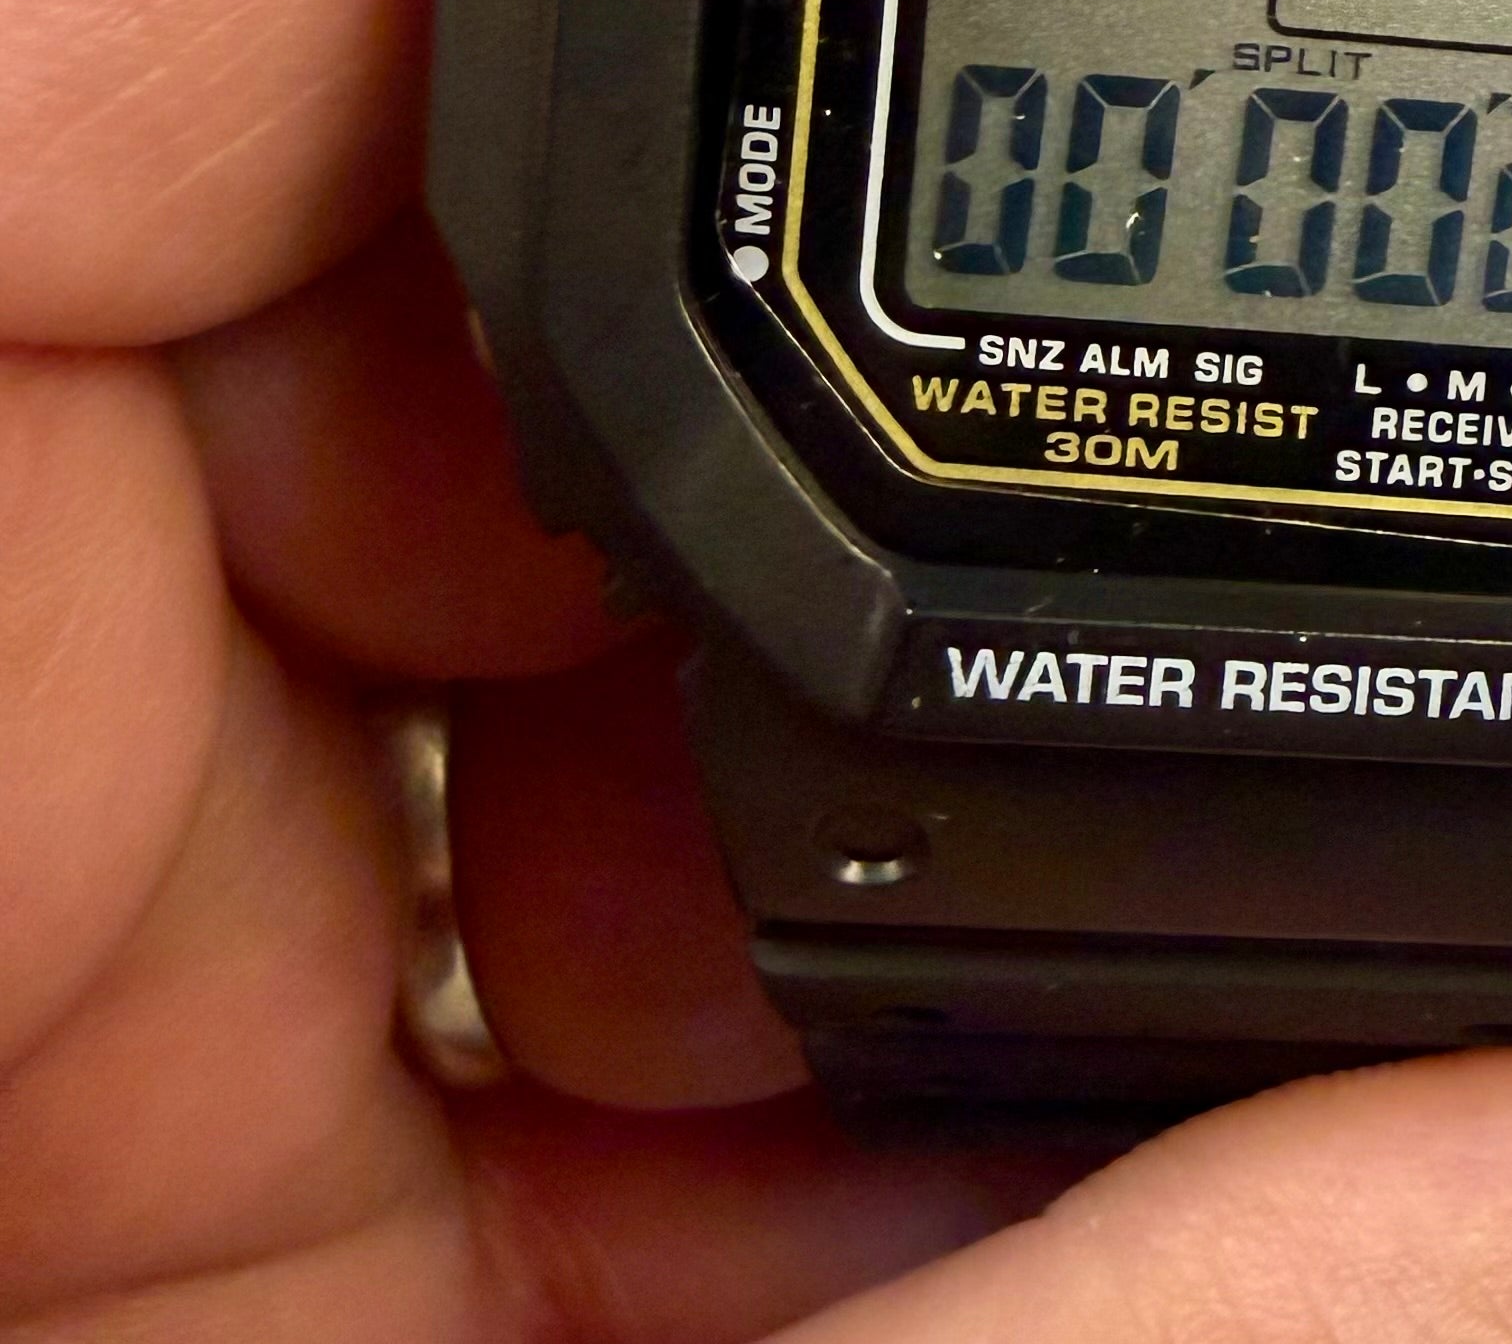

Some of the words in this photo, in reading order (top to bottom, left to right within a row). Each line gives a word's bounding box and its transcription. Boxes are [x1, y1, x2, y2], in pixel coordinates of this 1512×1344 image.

[1233, 44, 1372, 80] SPLIT
[735, 103, 782, 236] MODE
[978, 335, 1066, 372] SNZ
[1079, 345, 1170, 379] ALM
[1194, 352, 1264, 386] SIG
[911, 375, 1108, 424] WATER
[1127, 394, 1319, 440] RESIST
[1043, 431, 1180, 472] 30M
[946, 647, 1197, 709] WATER
